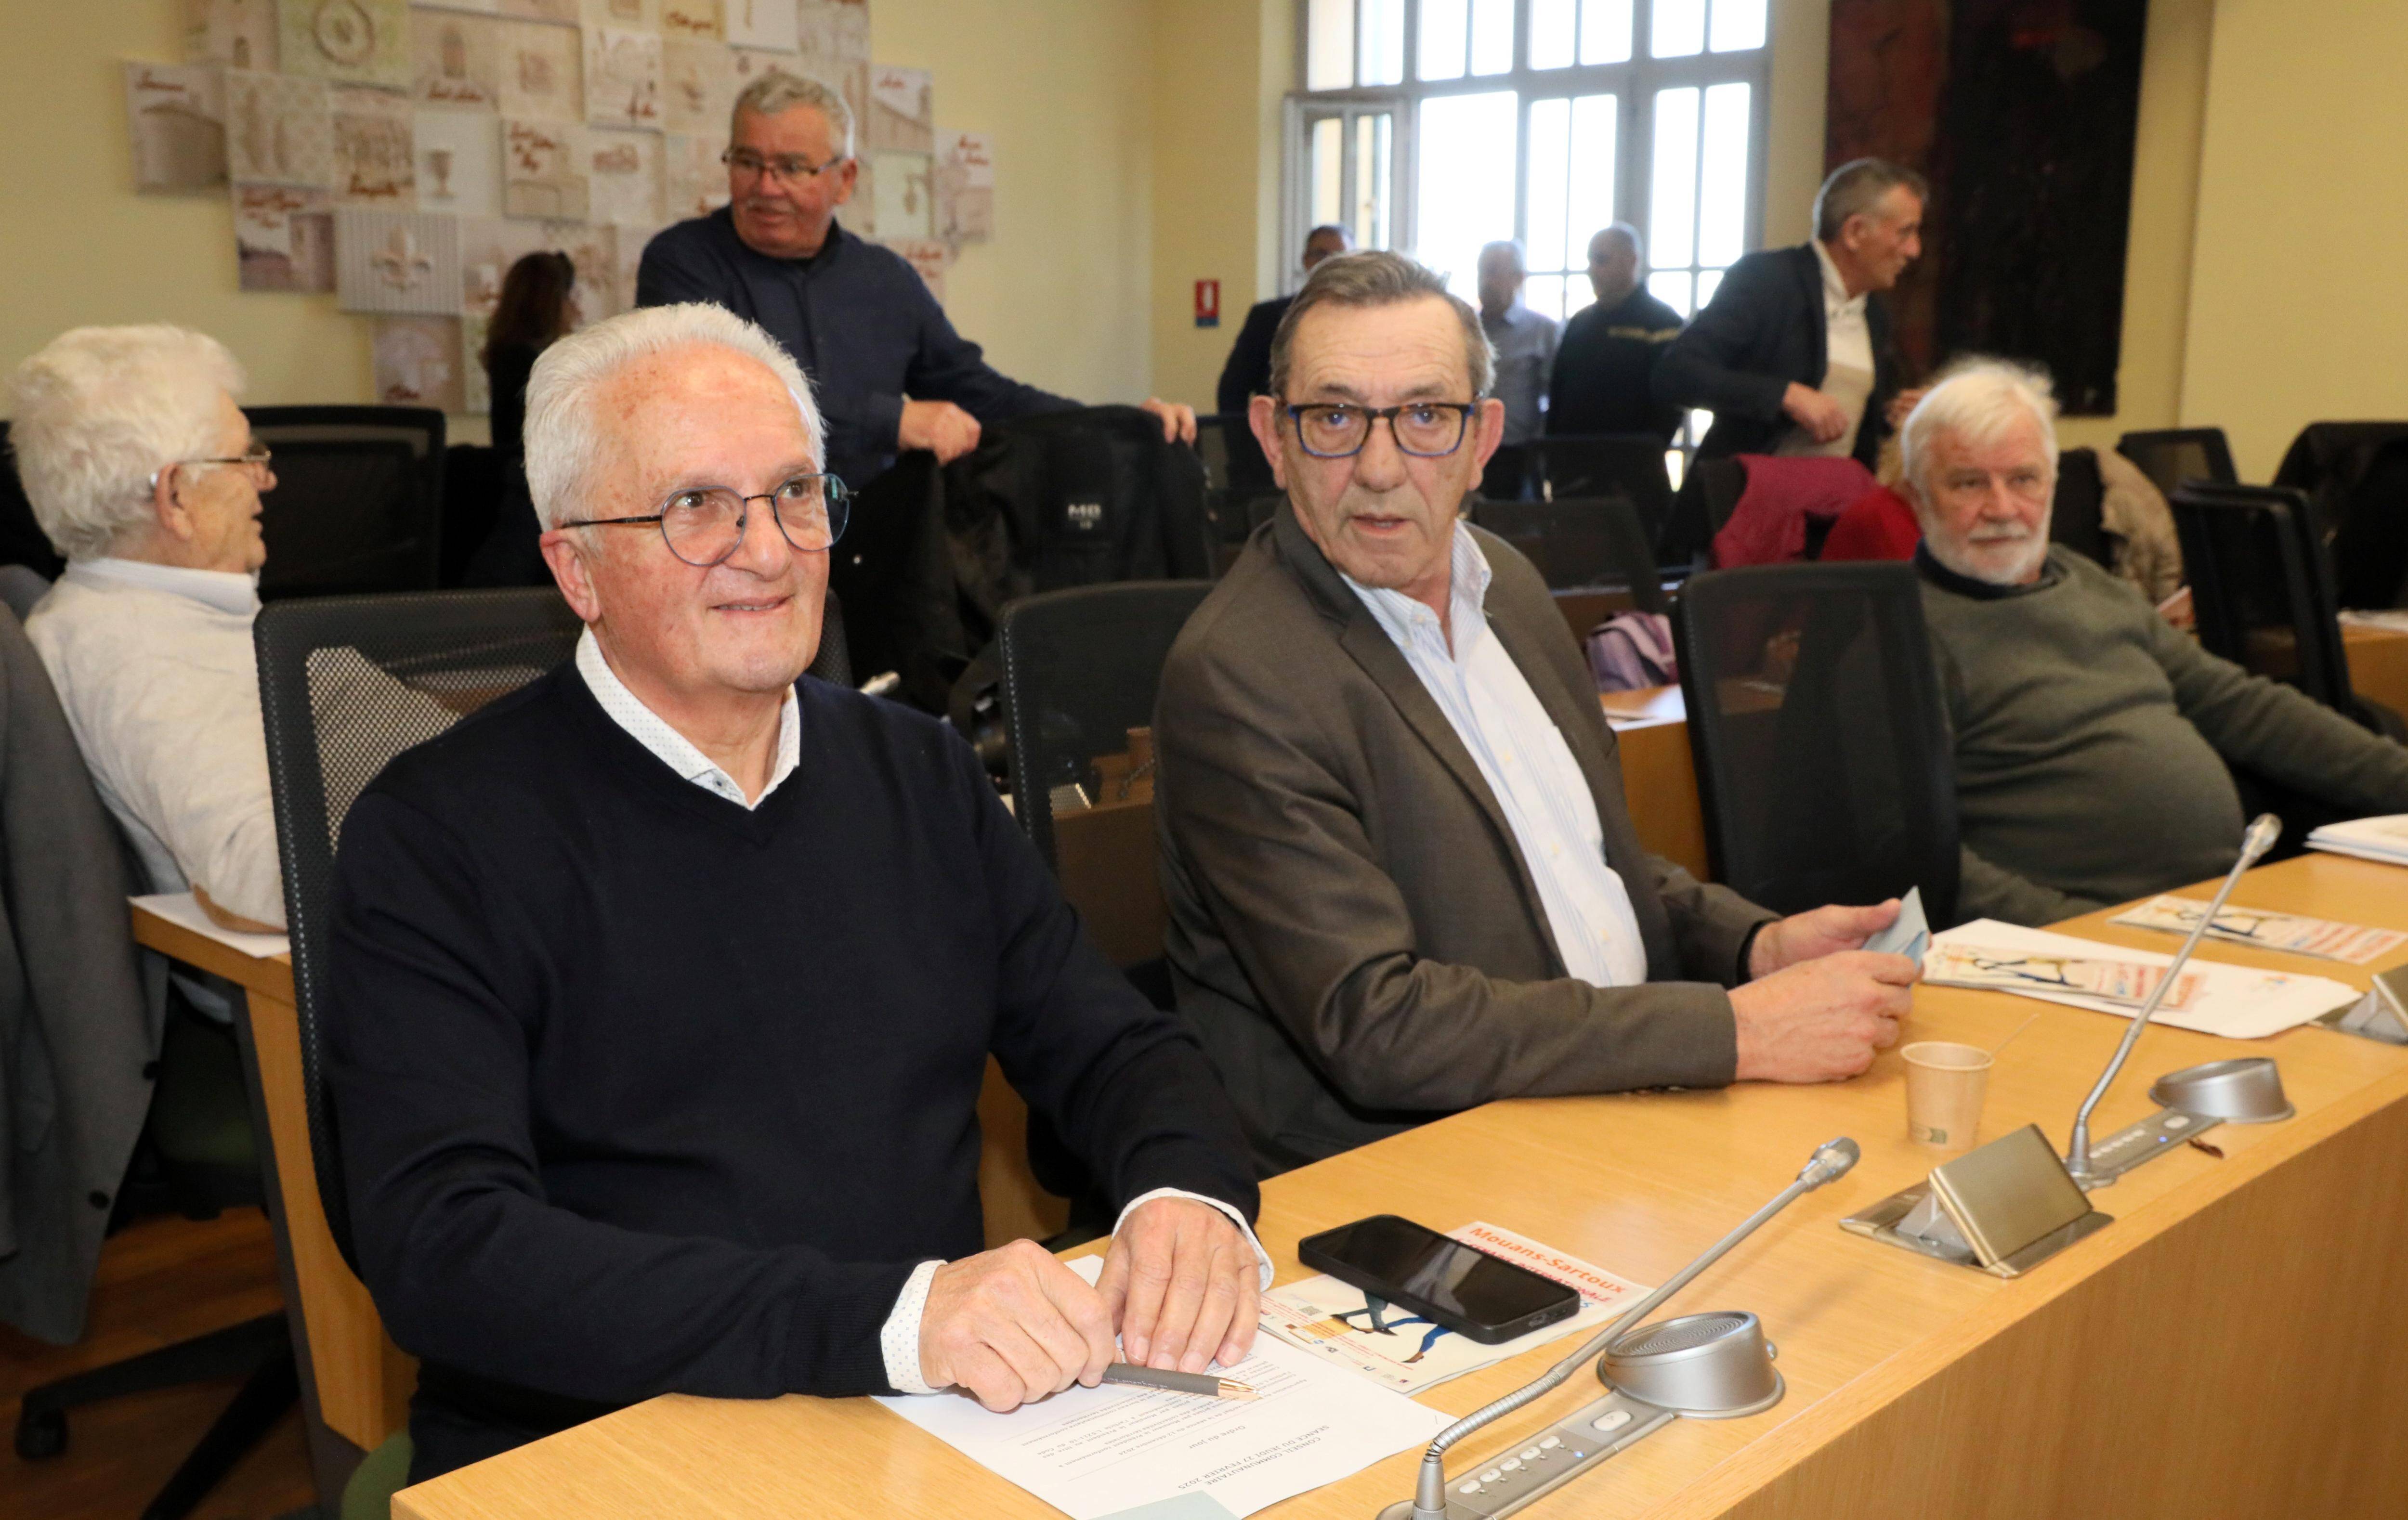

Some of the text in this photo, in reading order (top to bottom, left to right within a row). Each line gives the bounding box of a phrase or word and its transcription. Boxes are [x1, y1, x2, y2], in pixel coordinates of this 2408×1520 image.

[1468, 1227, 1625, 1293] Mouans-Sartoux
[1272, 1379, 1307, 1394] Approbation
[1099, 1397, 1136, 1412] collectivités
[1117, 1401, 1139, 1410] bureau
[1139, 1399, 1181, 1416] conformément
[1172, 1400, 1190, 1408] prises
[1191, 1401, 1214, 1412] général
[1192, 1407, 1211, 1416] prises
[1061, 1411, 1099, 1426] territoriales
[1069, 1409, 1116, 1428] communautaire
[1104, 1419, 1129, 1429] l'article
[1128, 1414, 1157, 1425] Monsieur
[1142, 1415, 1178, 1430] collectivités
[1152, 1419, 1180, 1431] Monsieur
[1186, 1419, 1207, 1428] séance
[1021, 1428, 1068, 1446] conformément
[1069, 1430, 1102, 1443] L.5211-10
[1086, 1429, 1117, 1442] Président
[1104, 1429, 1142, 1444] territoriales
[1220, 1426, 1245, 1436] Ordre
[1296, 1426, 1329, 1441] SEANCE
[1113, 1434, 1143, 1447] Président
[1136, 1435, 1166, 1448] décembre
[1188, 1440, 1207, 1448] jour
[1064, 1446, 1111, 1465] conformément
[1255, 1445, 1282, 1457] JEUDI
[1205, 1437, 1321, 1485] CONSEIL COMMUNAUTAIRE
[1203, 1461, 1242, 1478] FEVRIER
[1178, 1478, 1202, 1489] 2025
